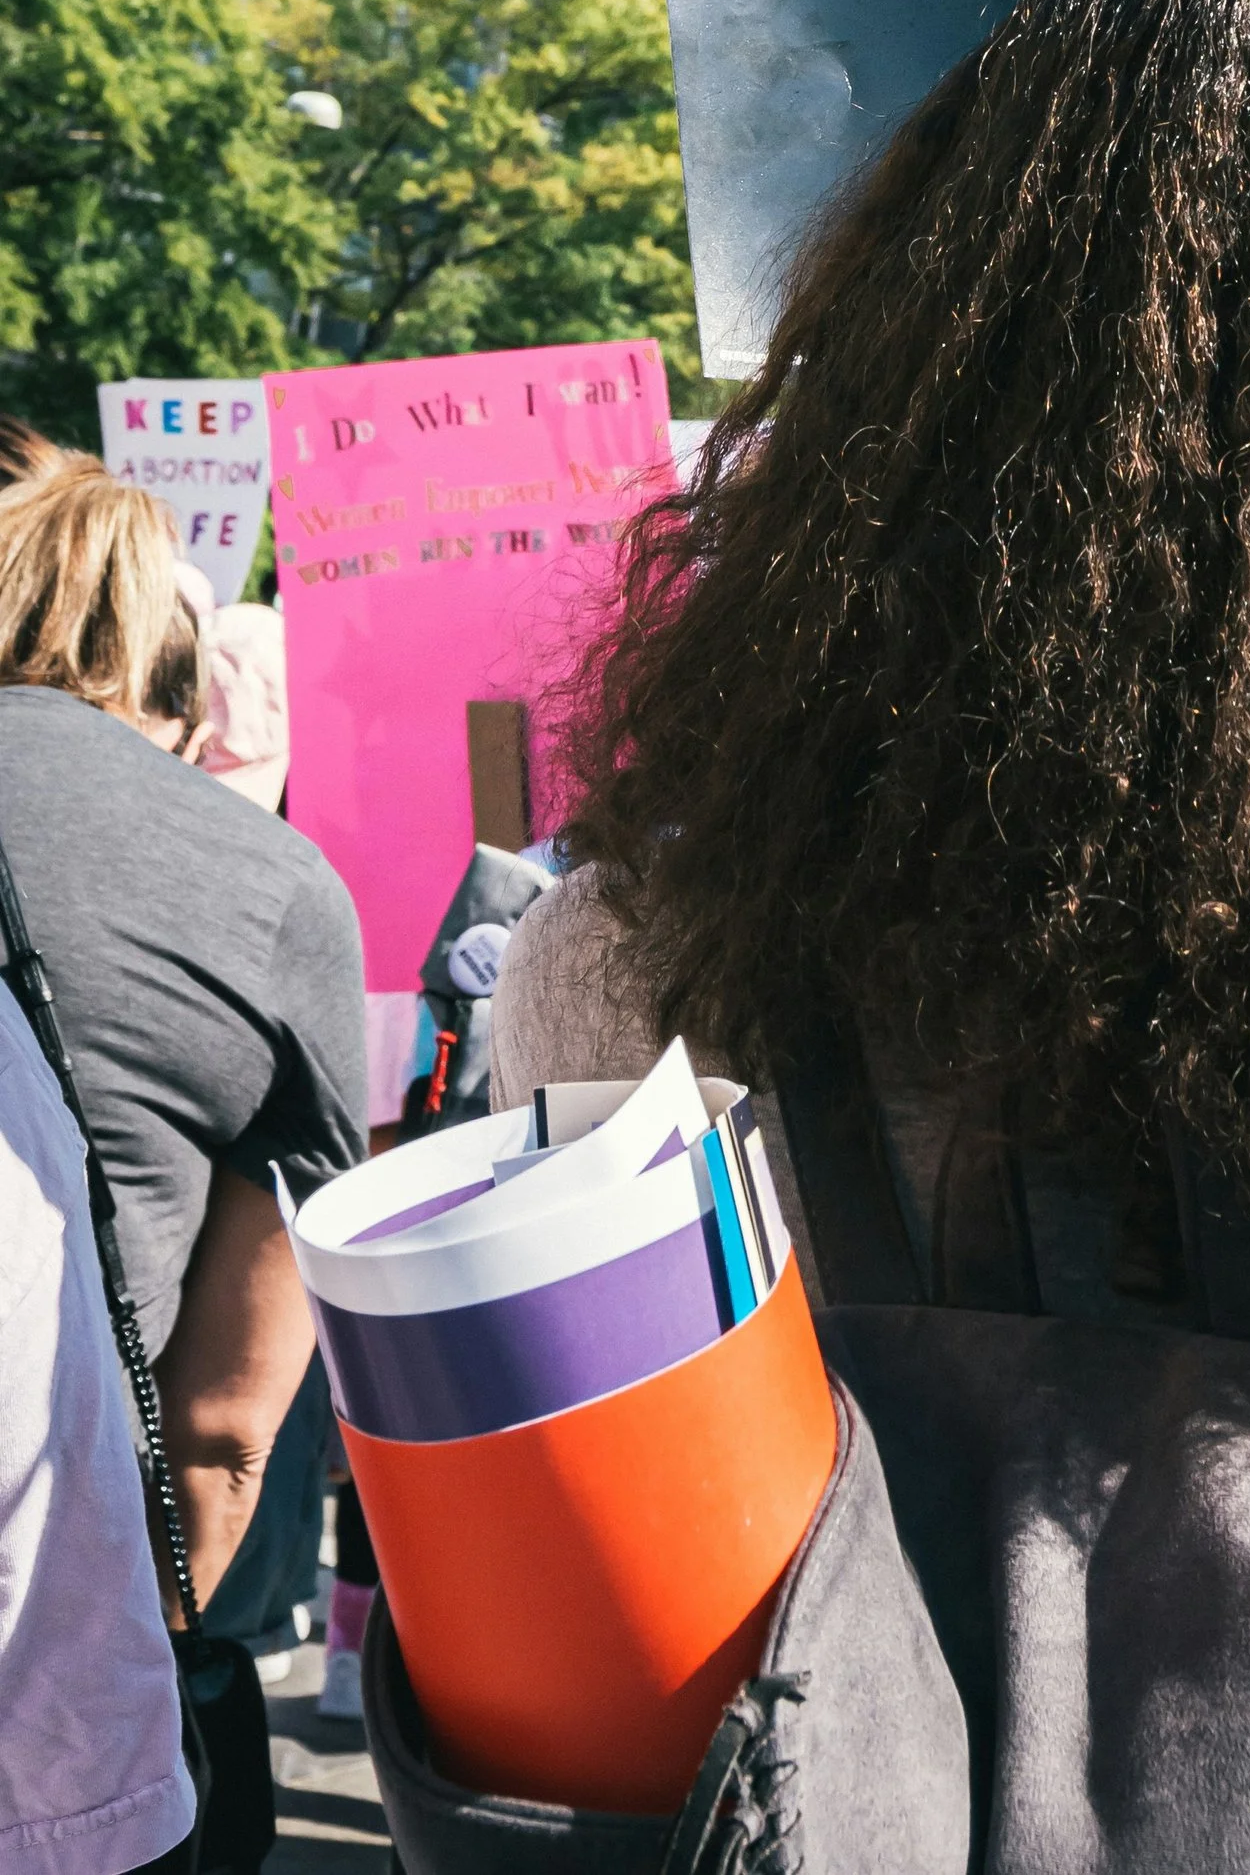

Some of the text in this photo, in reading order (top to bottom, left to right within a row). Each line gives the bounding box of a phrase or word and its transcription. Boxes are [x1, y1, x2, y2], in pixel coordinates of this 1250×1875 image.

[124, 398, 254, 436] KEEP
[295, 352, 643, 463] I Do What I want!
[121, 457, 262, 486] ABORTION
[297, 549, 400, 585] WOMEN
[420, 536, 474, 563] RUN
[489, 527, 549, 555] THE
